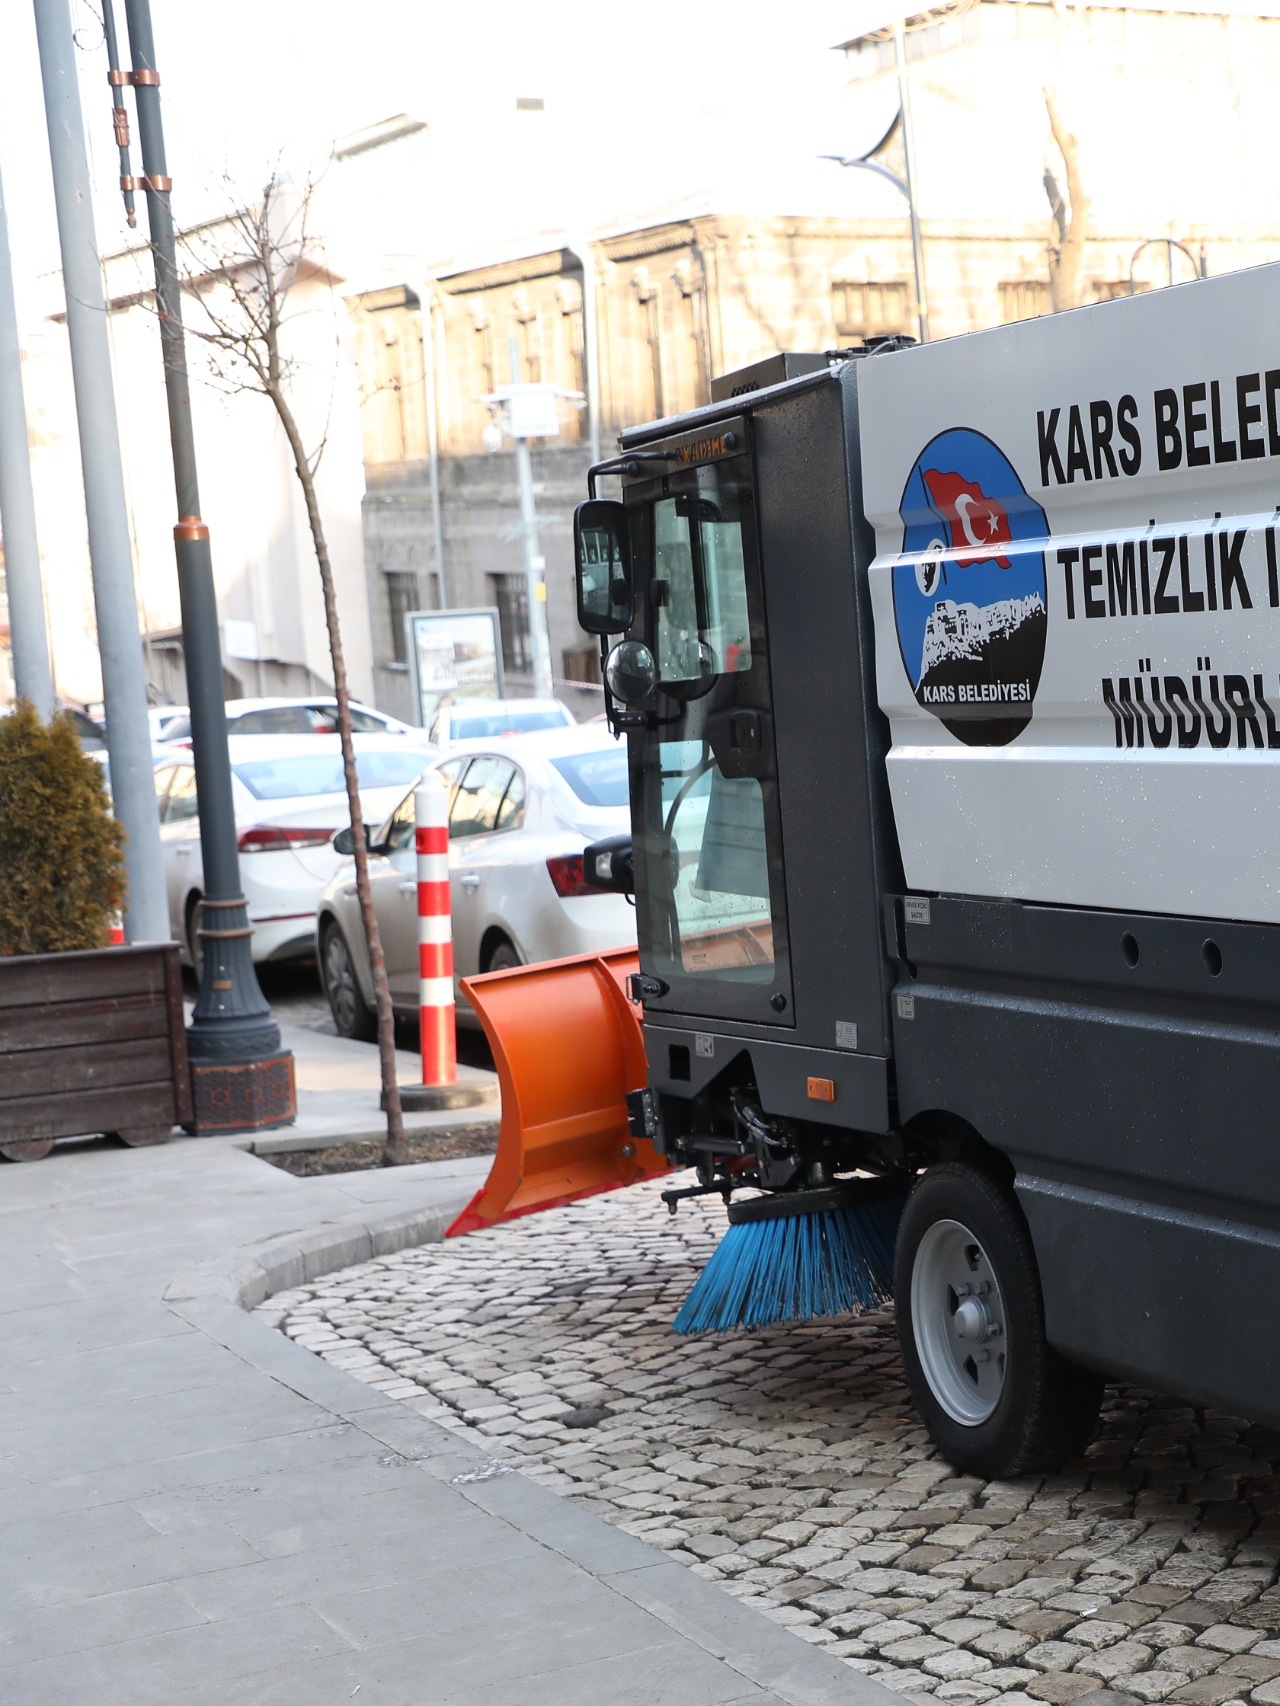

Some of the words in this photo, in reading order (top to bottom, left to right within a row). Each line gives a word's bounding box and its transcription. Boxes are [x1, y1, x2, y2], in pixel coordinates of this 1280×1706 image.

[1037, 393, 1142, 487] KARS
[1057, 512, 1254, 620] TEMİZLİK
[923, 685, 955, 702] KARS
[958, 679, 1031, 702] BELEDİYESİ
